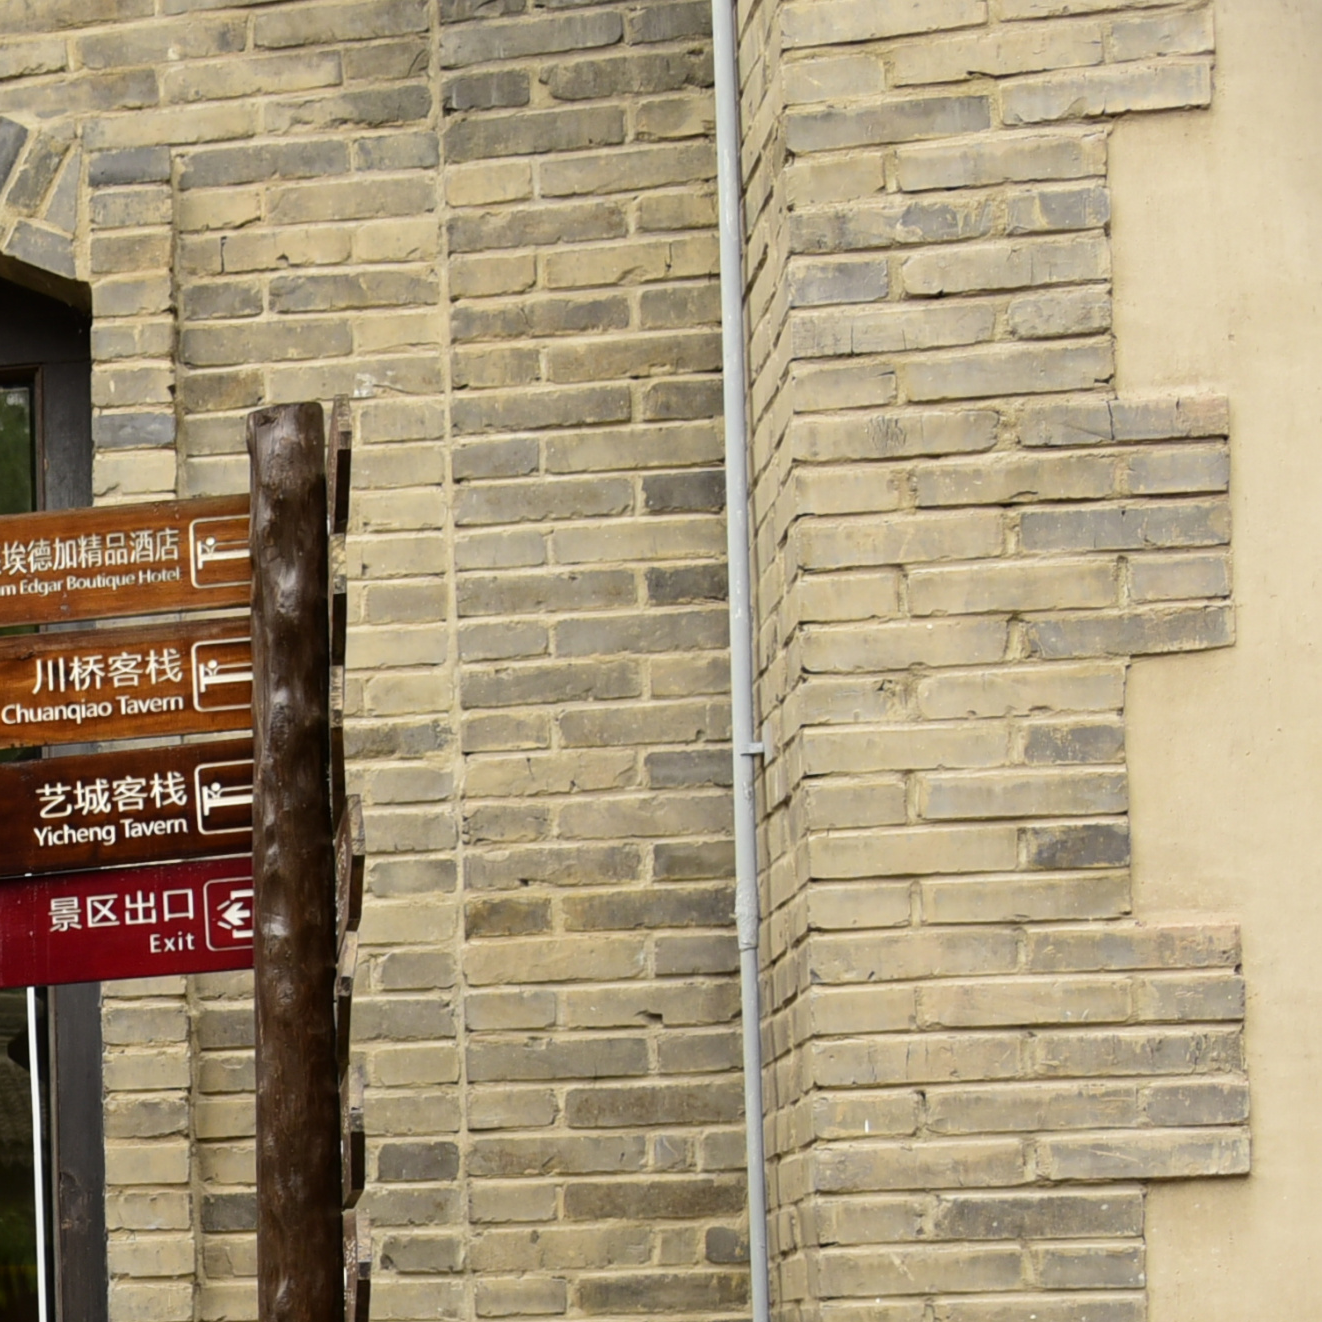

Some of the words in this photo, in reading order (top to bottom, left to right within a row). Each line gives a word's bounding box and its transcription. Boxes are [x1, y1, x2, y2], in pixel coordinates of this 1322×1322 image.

[19, 579, 63, 598] Edgar
[66, 572, 136, 591] Boutique
[138, 566, 180, 584] Hotel
[31, 648, 183, 696] 川桥客栈
[0, 699, 113, 726] Chuanqiao
[115, 694, 184, 715] Tavern
[35, 772, 188, 819] 艺城客栈
[33, 823, 116, 848] Yicheng
[119, 816, 188, 837] Tavern
[47, 888, 195, 932] 景区出口
[149, 933, 195, 953] Exit
